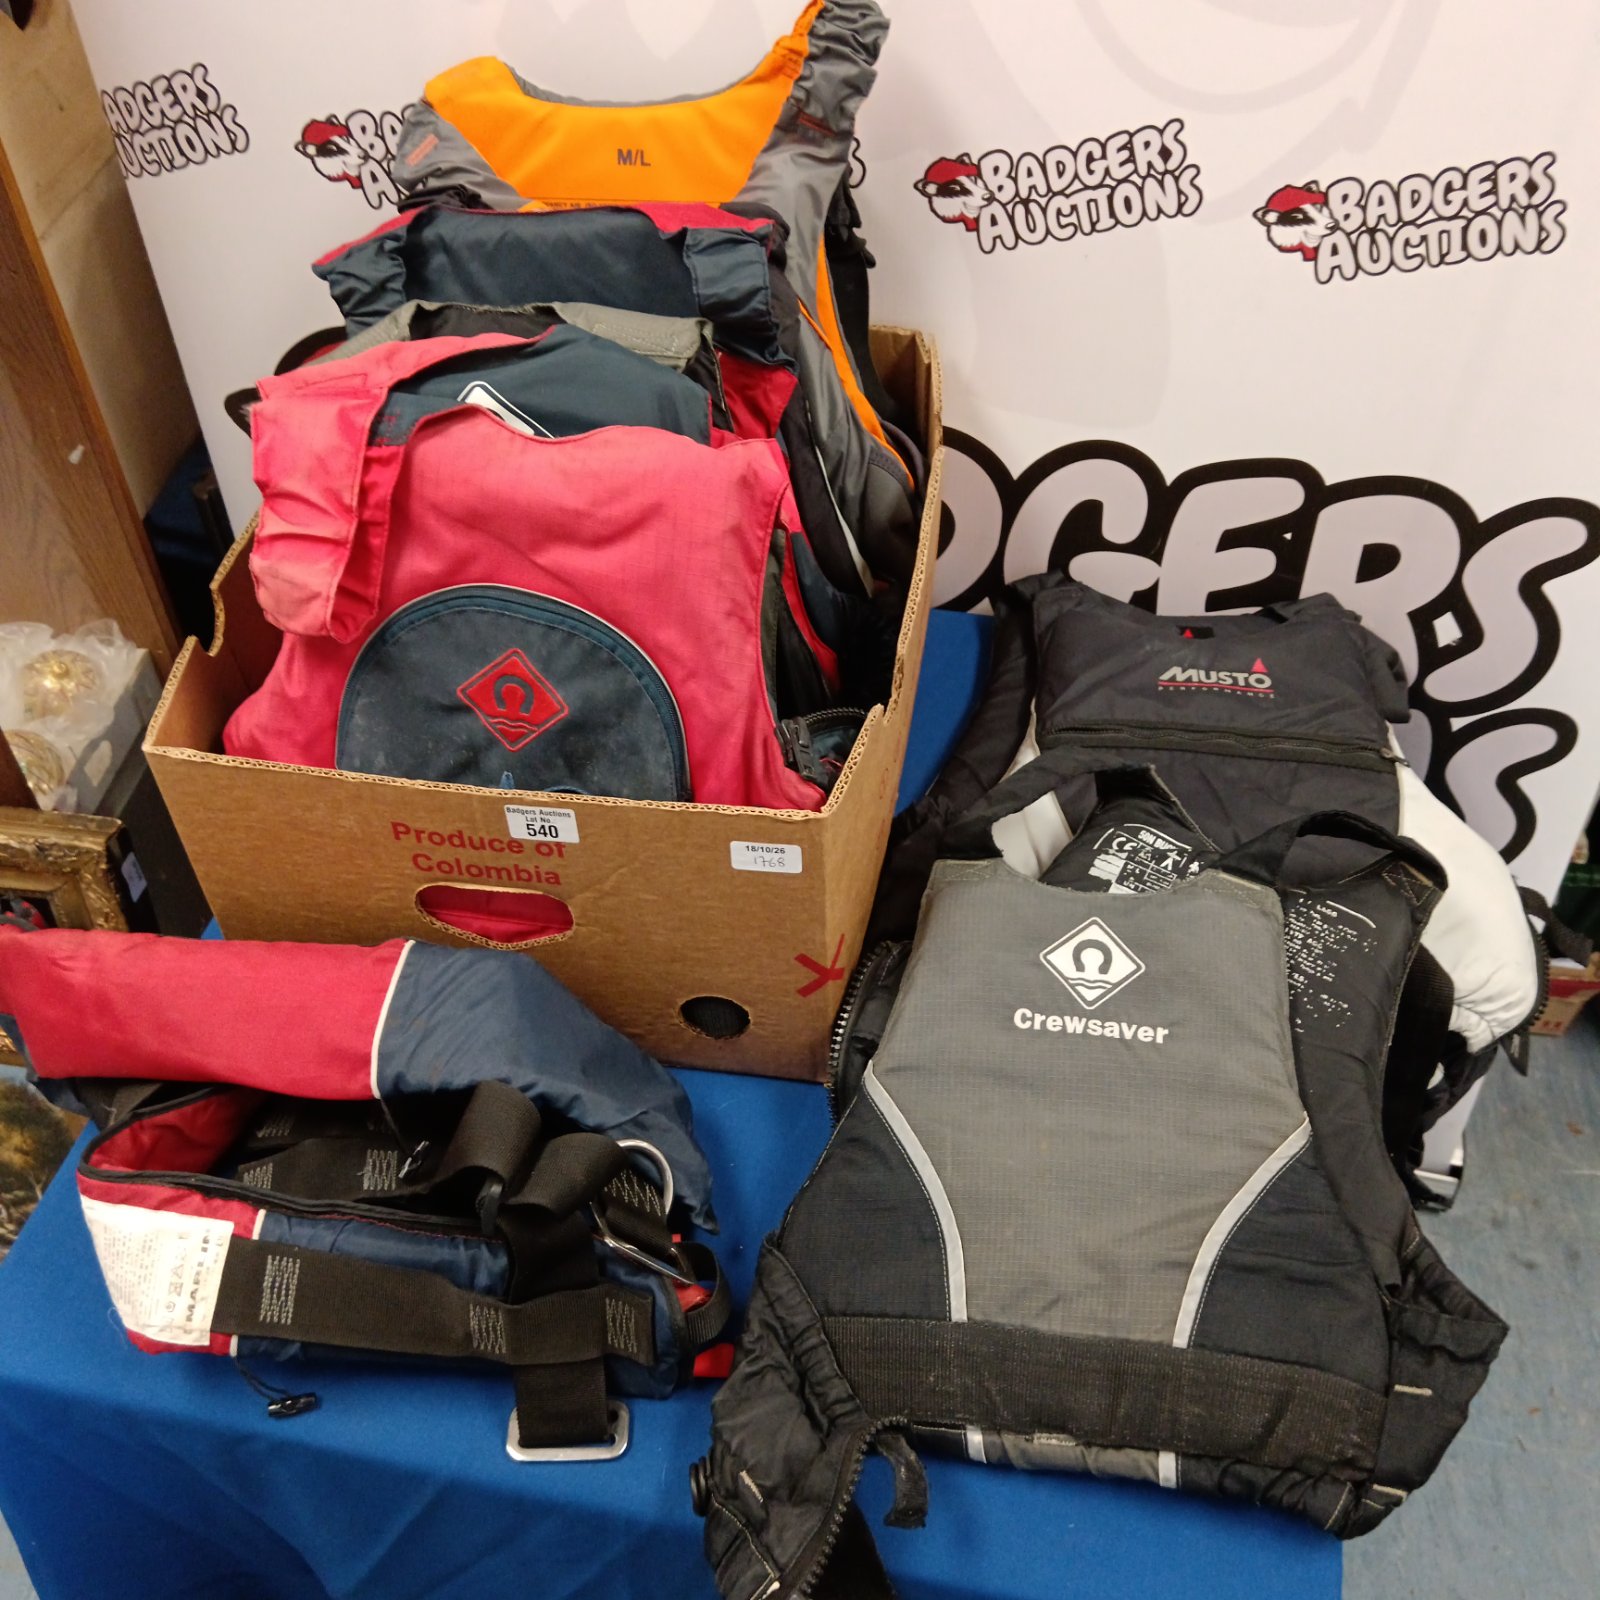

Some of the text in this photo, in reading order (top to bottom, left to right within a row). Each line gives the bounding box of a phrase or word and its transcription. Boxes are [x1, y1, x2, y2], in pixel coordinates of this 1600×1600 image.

[616, 148, 652, 167] M/L
[978, 118, 1187, 206] BADGERS
[1326, 151, 1557, 235] BADGERS
[976, 163, 1203, 254] AUCTIONS
[1315, 199, 1568, 285] AUCTIONS
[1158, 665, 1273, 689] MUSTO
[506, 806, 572, 819] Badgers Auctions
[525, 815, 538, 823] Lot
[390, 821, 567, 858] Produce of
[526, 823, 559, 839] 540
[745, 845, 786, 854] 18/10/26
[753, 856, 786, 868] 1768
[411, 853, 562, 886] Colombia
[1013, 1007, 1169, 1044] Crewsaver
